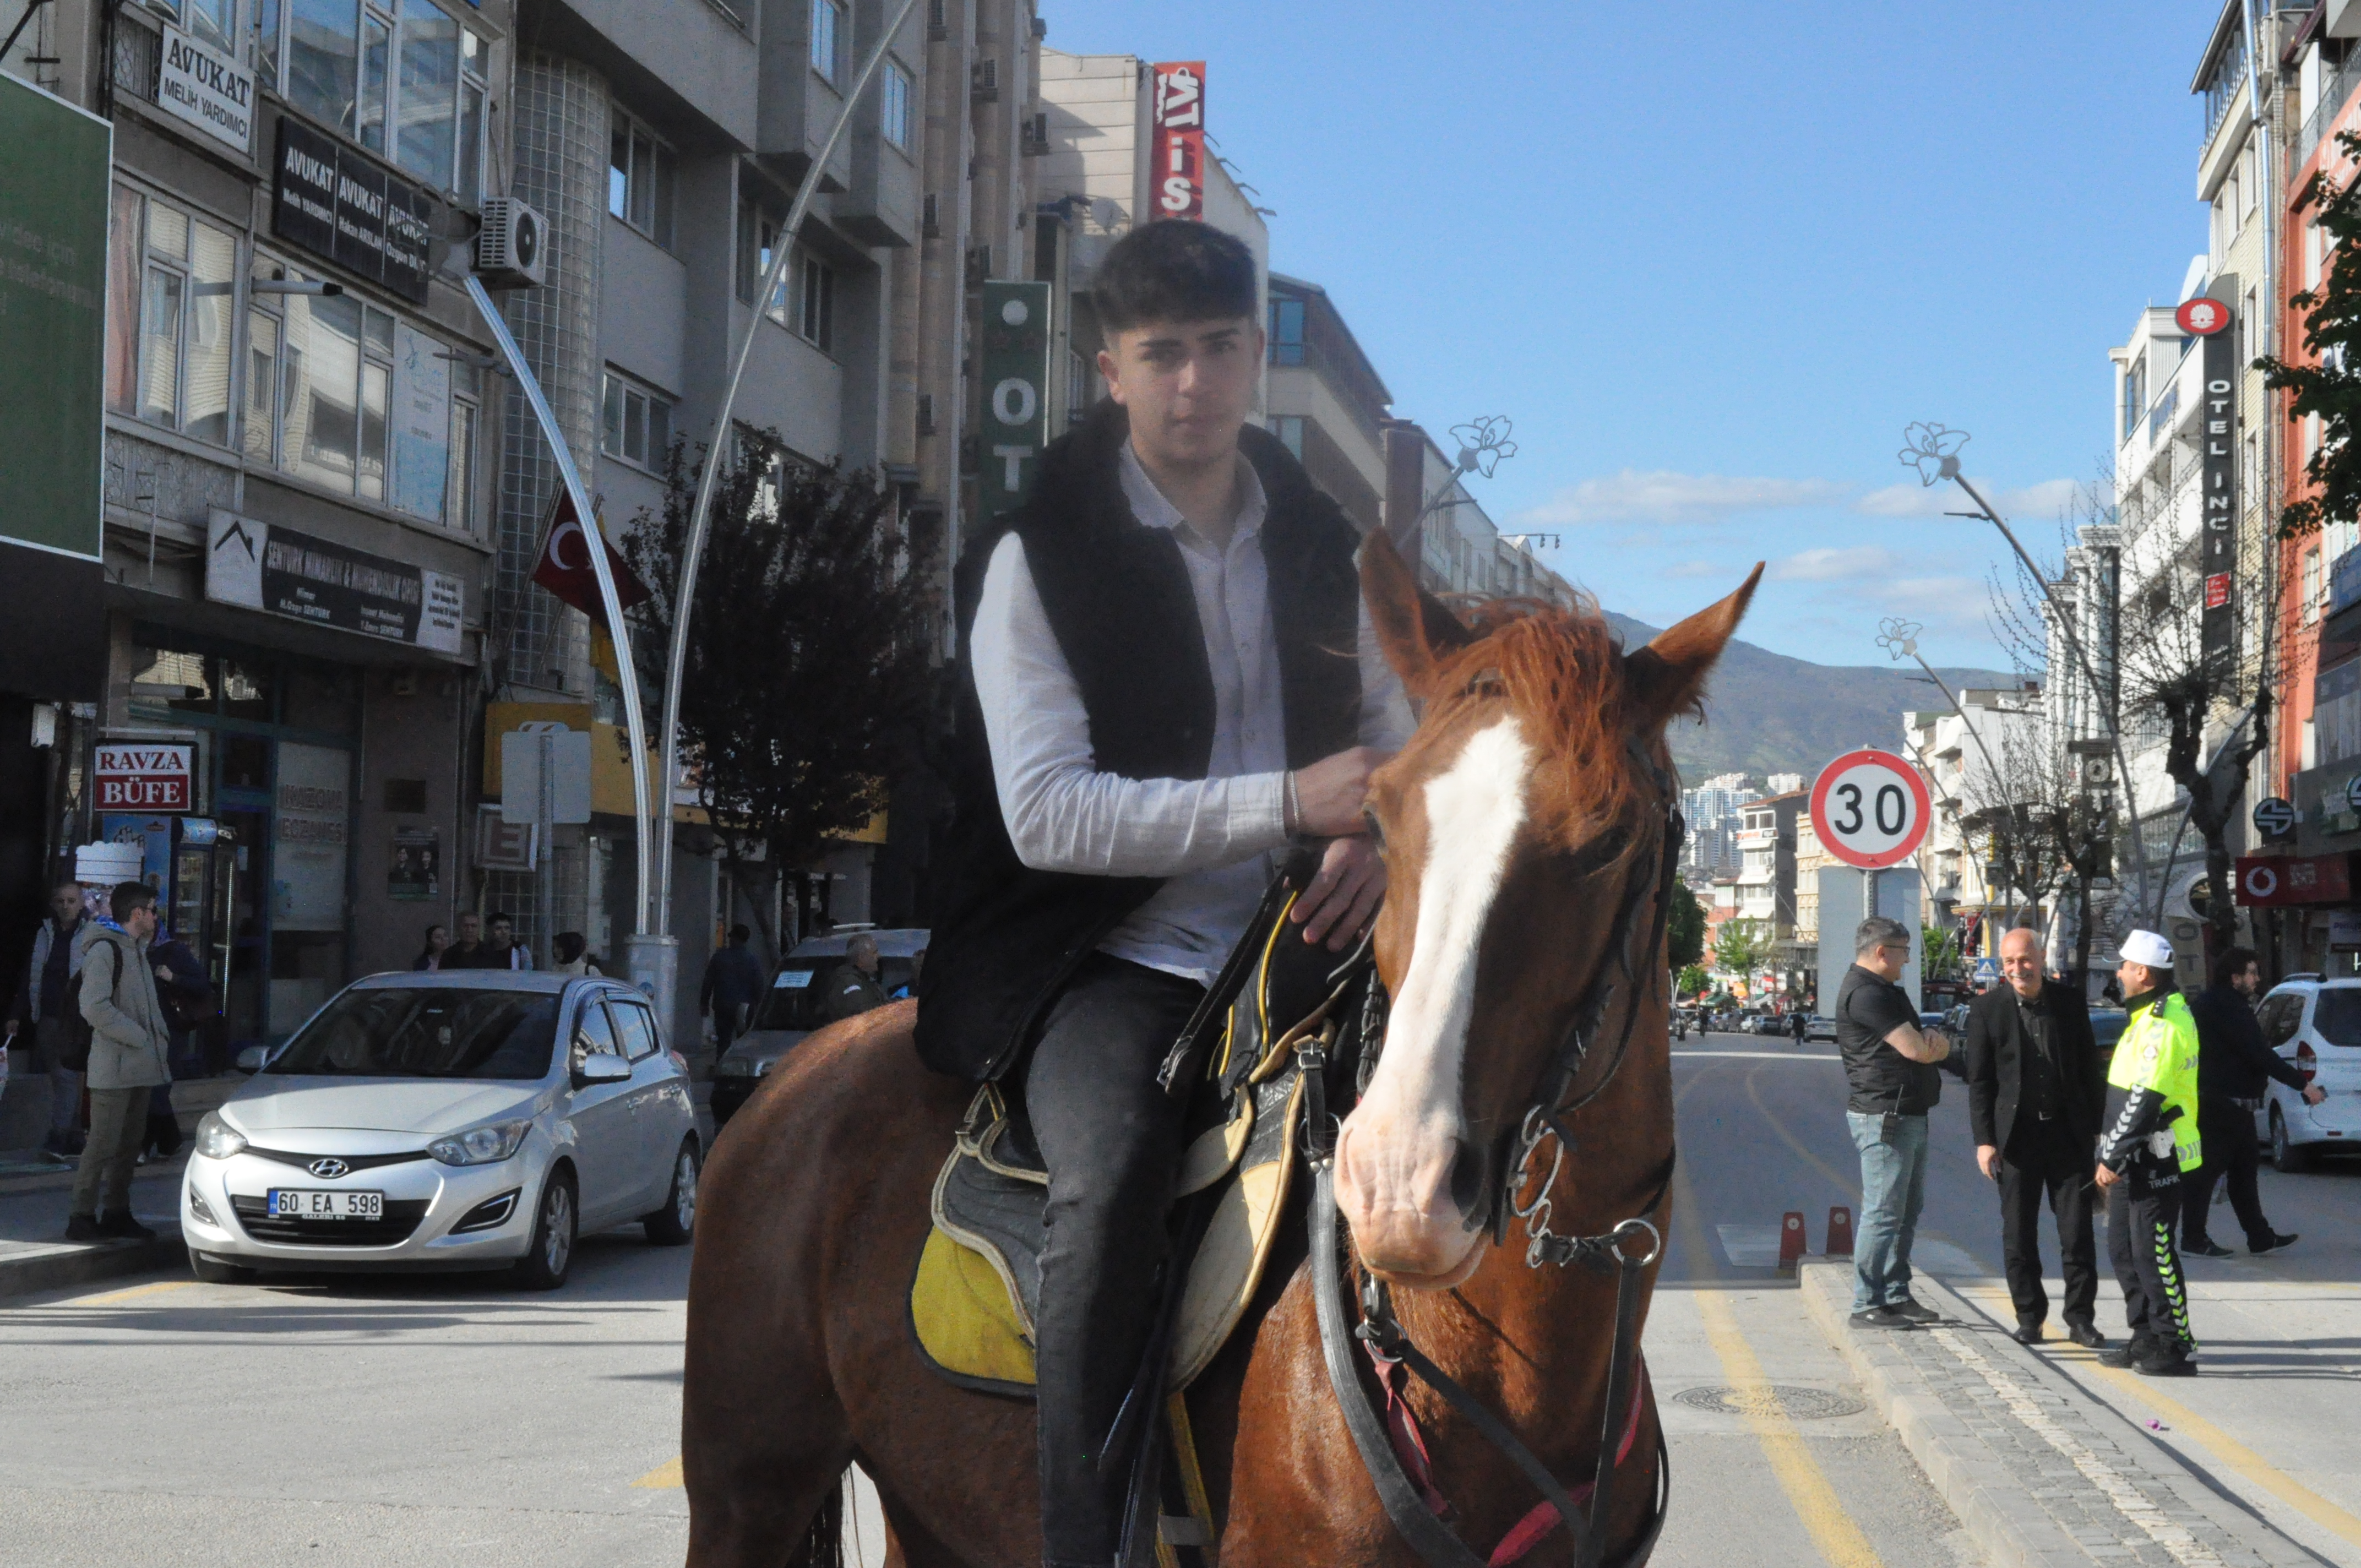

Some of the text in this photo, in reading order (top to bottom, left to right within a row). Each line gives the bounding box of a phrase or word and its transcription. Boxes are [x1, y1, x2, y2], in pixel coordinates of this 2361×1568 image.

[167, 39, 250, 107] AVUKAT
[164, 77, 248, 138] MELİH YARDIMCI
[285, 147, 334, 193] AVUKAT
[338, 176, 383, 219] AVUKAT
[2208, 379, 2231, 455] OTEL
[100, 752, 184, 770] RAVZA
[103, 776, 181, 804] BÜFE
[1834, 783, 1906, 836] 30
[279, 1193, 379, 1213] 60 EA 598
